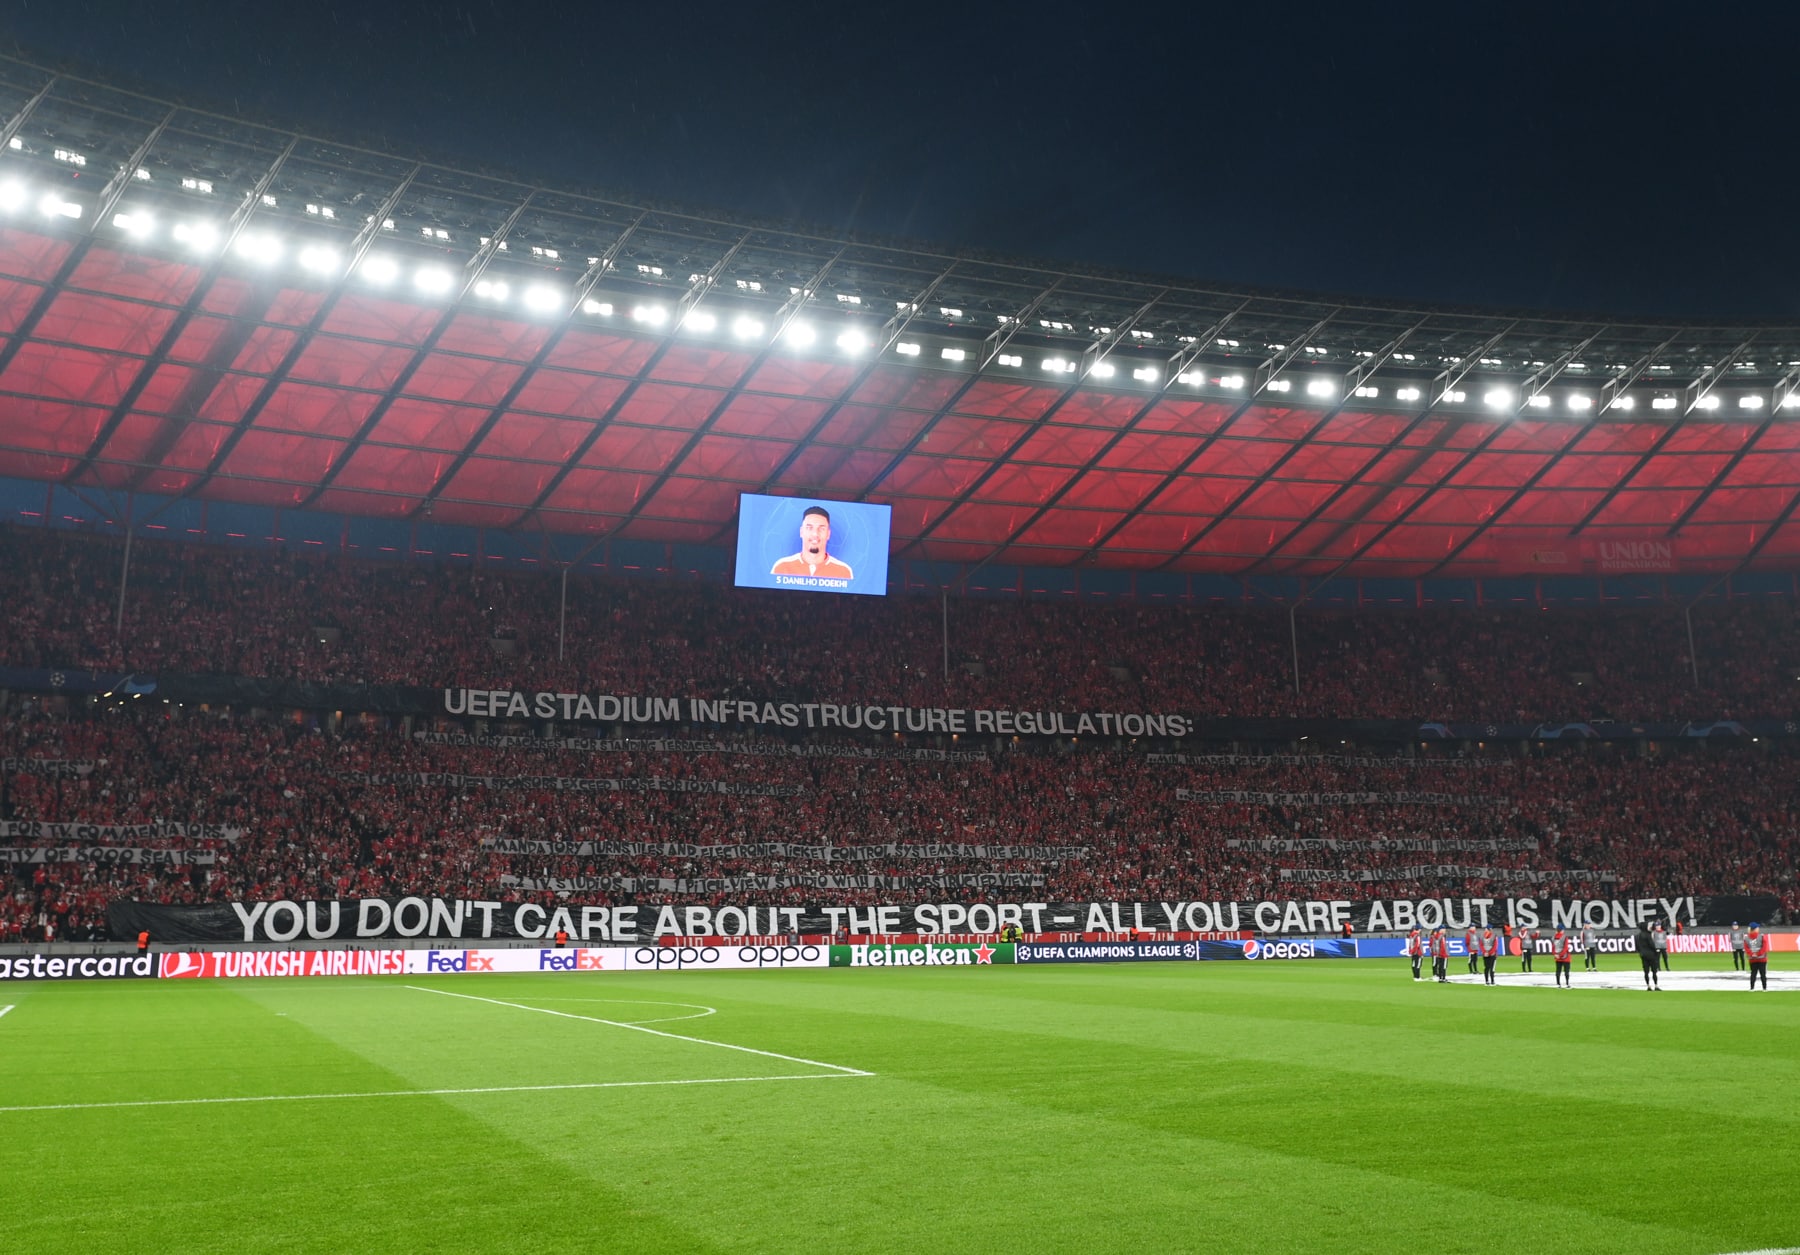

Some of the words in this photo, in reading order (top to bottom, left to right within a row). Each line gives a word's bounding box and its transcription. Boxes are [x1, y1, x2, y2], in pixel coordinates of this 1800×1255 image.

[1600, 541, 1672, 560] UNION
[776, 576, 781, 584] 5
[445, 688, 530, 717] UEFA
[534, 692, 681, 722] STADIUM
[691, 698, 966, 733] INFRASTRUCTURE
[974, 710, 1194, 737] REGULATIONS:
[919, 749, 940, 760] AND
[8, 822, 42, 836] FOR
[45, 848, 69, 863] OF
[76, 848, 134, 863] 8000
[984, 846, 1006, 858] THE
[556, 876, 622, 890] STUDIOS
[775, 875, 827, 888] STUDIO
[874, 875, 894, 888] AN
[231, 899, 340, 942] YOU
[356, 896, 502, 939] DON'T
[514, 902, 639, 942] CARE
[653, 905, 806, 937] ABOUT
[821, 906, 901, 937] THE
[914, 902, 1047, 935] SPORT
[1086, 901, 1156, 933] ALL
[1160, 901, 1240, 933] YOU
[1255, 900, 1352, 934] CARE
[1367, 897, 1494, 933] ABOUT
[1507, 897, 1541, 930] IS
[1552, 896, 1698, 930] MONEY!
[1034, 945, 1064, 960] UEFA
[1067, 944, 1135, 959] CHAMPIONS
[1139, 943, 1181, 958] LEAGUE
[1263, 940, 1315, 960] pepsi
[1535, 935, 1636, 954] mstrcard
[1668, 933, 1719, 953] TURKISH
[212, 951, 304, 977] TURKISH
[310, 949, 403, 976] AIRLINES
[427, 950, 494, 972] FedEx
[540, 949, 604, 971] FedEx
[635, 947, 719, 969] oppo
[738, 945, 820, 967] oppo
[850, 944, 972, 966] Heineken
